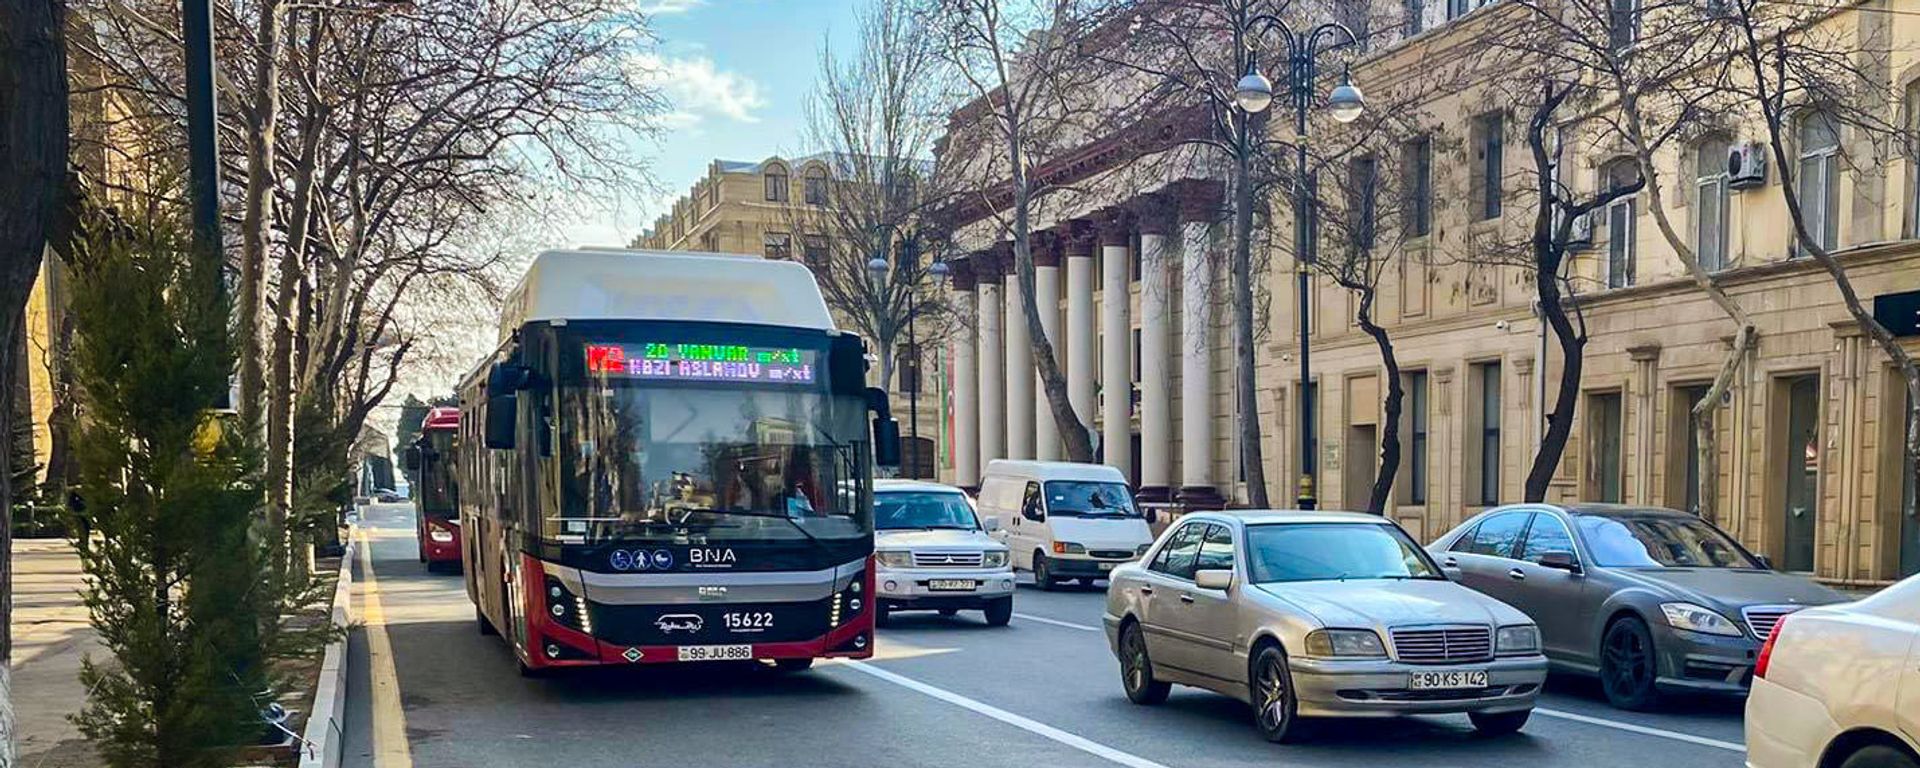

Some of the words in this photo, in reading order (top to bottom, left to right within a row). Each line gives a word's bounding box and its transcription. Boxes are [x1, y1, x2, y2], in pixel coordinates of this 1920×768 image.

[645, 343, 669, 358] 20
[690, 549, 736, 562] BNA
[723, 612, 773, 627] 15622
